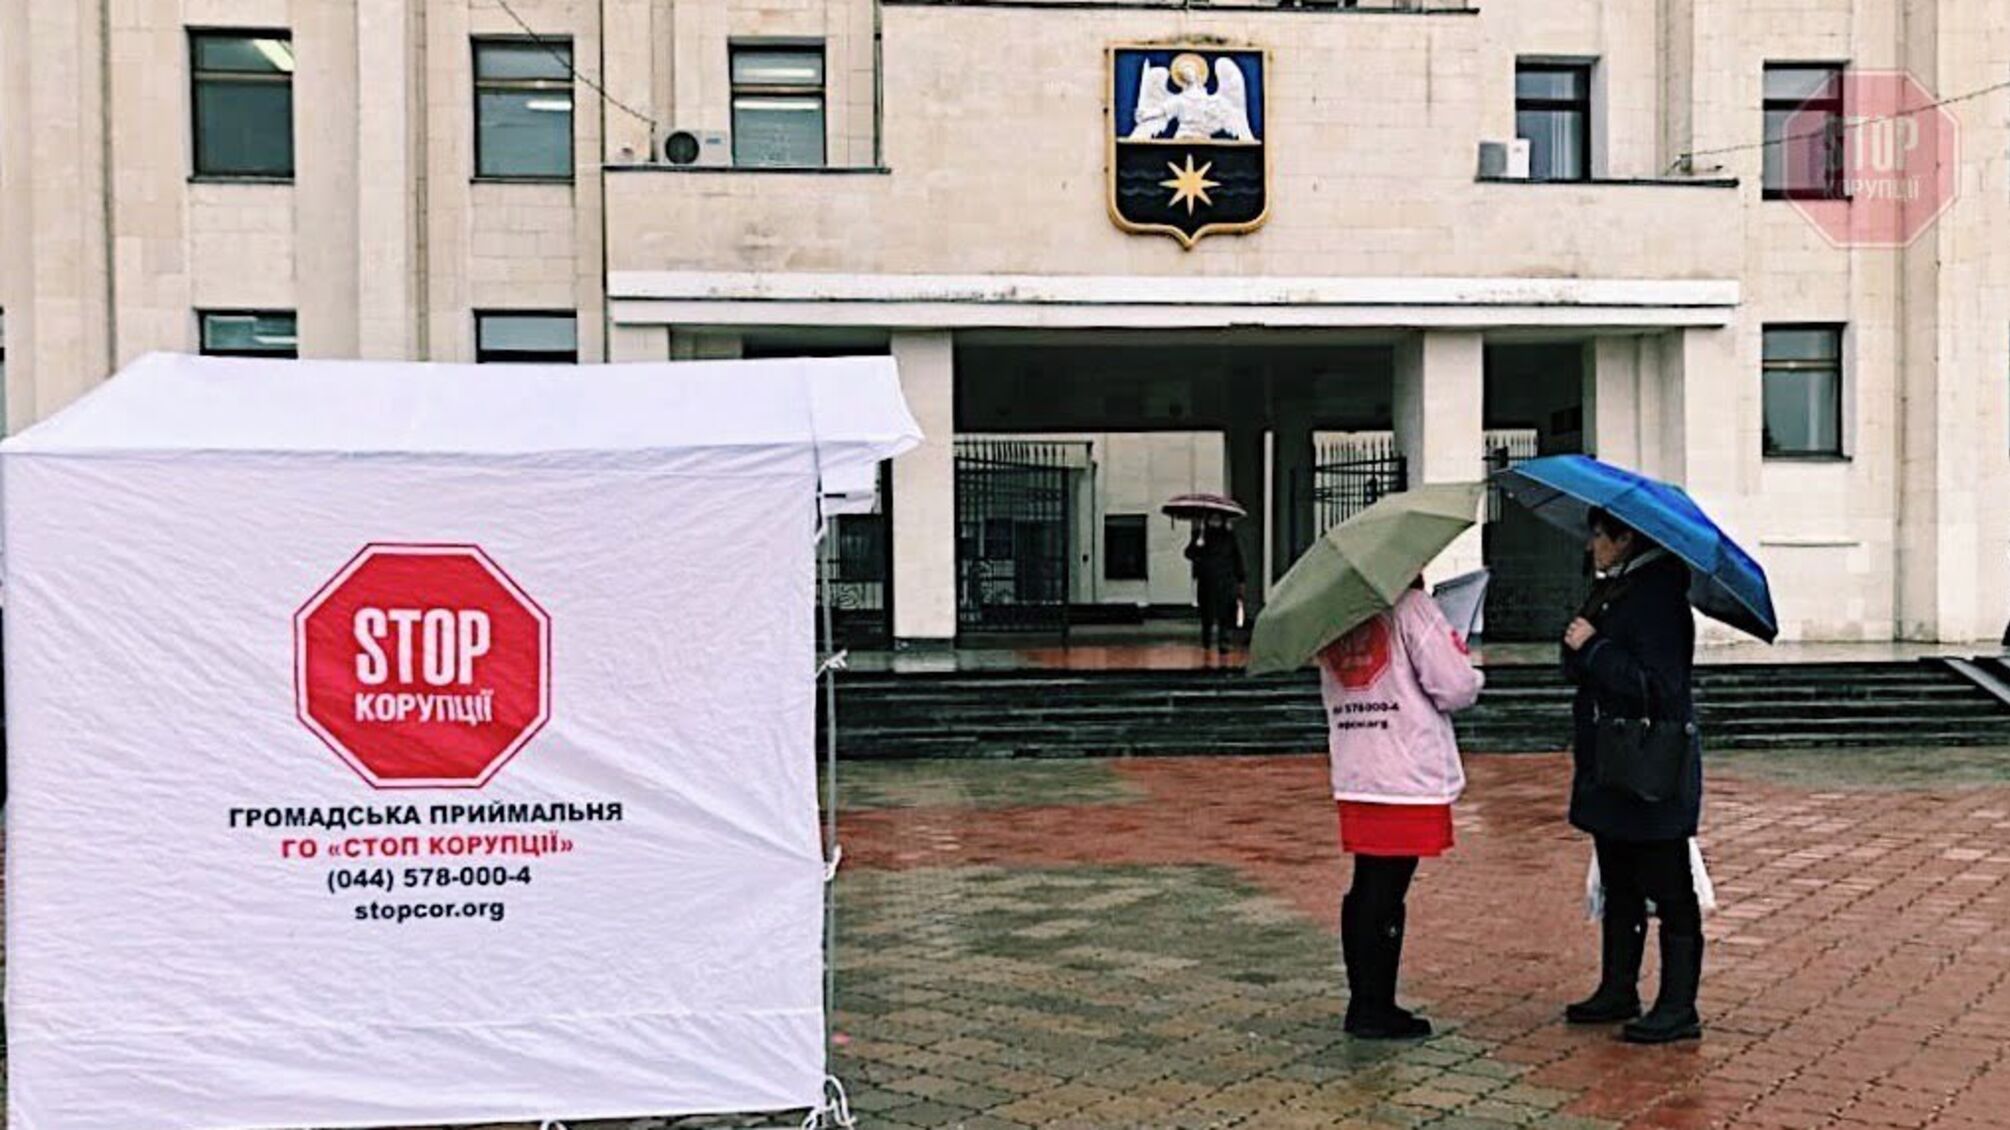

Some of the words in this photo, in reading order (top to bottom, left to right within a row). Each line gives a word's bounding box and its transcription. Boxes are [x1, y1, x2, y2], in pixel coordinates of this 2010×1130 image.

[353, 607, 491, 686] STOP
[355, 688, 495, 727] КОРУПЦІЇ
[229, 804, 421, 831] ГРОМАДСЬКА
[430, 800, 623, 824] ПРИЙМАЛЬНЯ
[282, 838, 317, 859] ГО
[328, 836, 419, 858] «СТОП
[429, 830, 574, 857] КОРУПЦІЇ»
[327, 868, 394, 894] (044)
[403, 866, 531, 888] 578-000-4
[354, 901, 505, 924] stopcor.org
